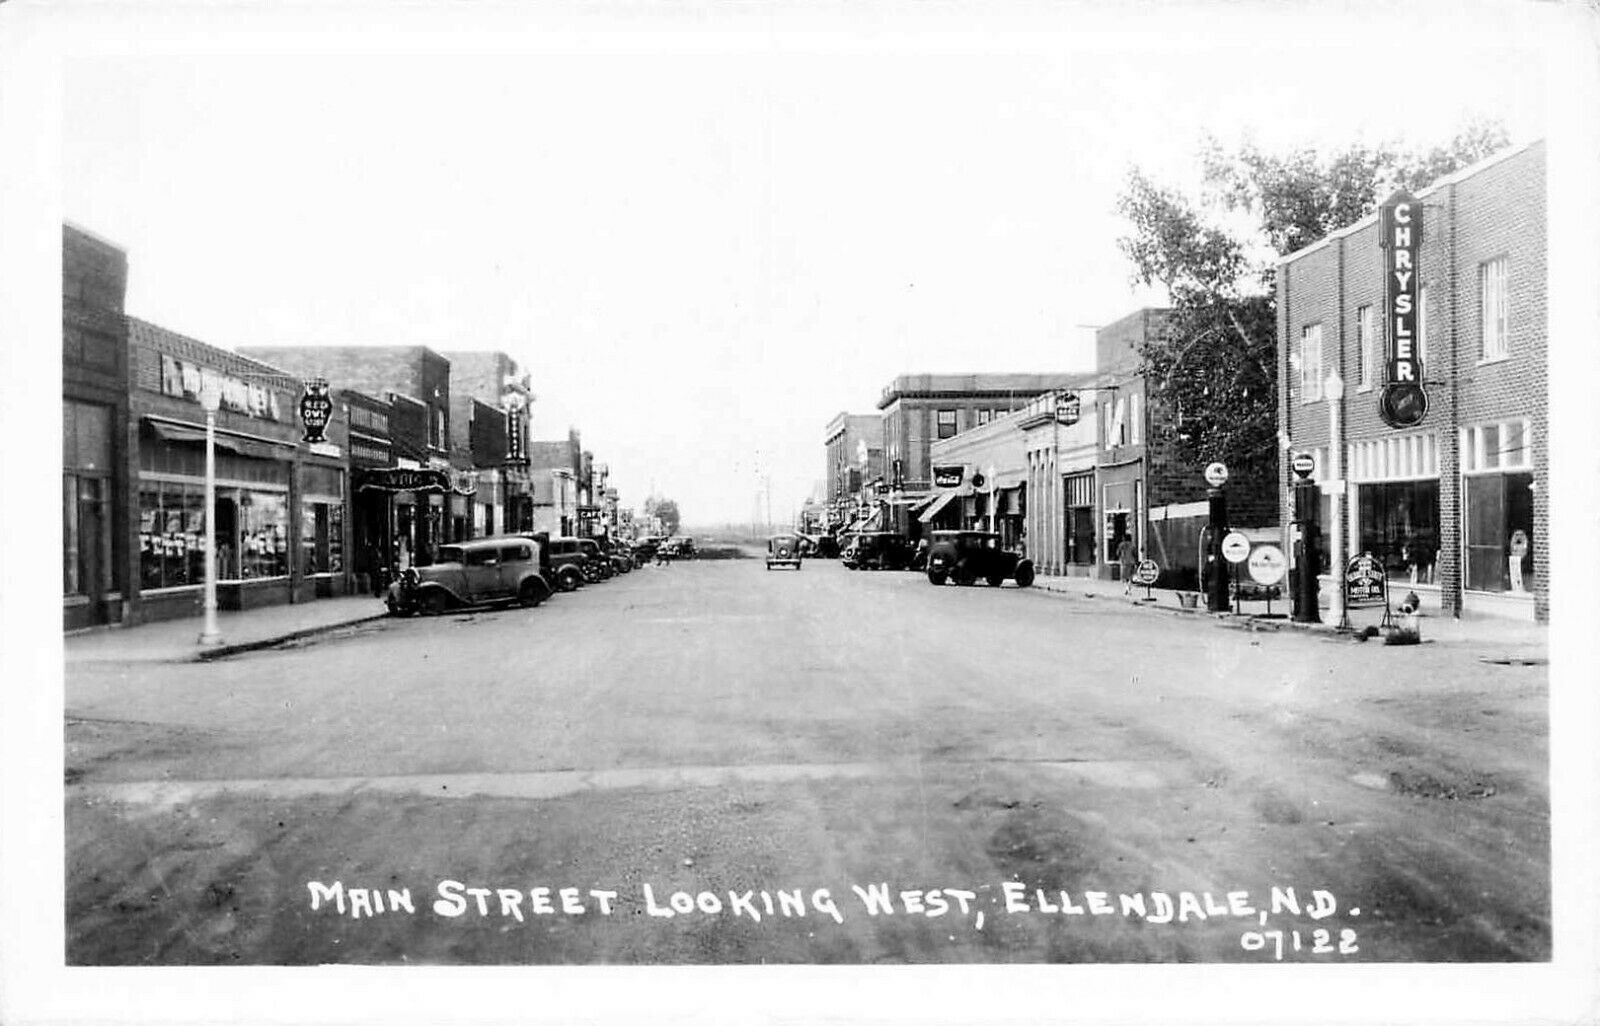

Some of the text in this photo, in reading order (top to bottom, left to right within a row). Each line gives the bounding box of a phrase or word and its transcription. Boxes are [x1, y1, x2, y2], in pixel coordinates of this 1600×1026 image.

[1394, 203, 1414, 381] CHRYSLER
[304, 400, 329, 409] RED
[304, 409, 326, 418] OWL
